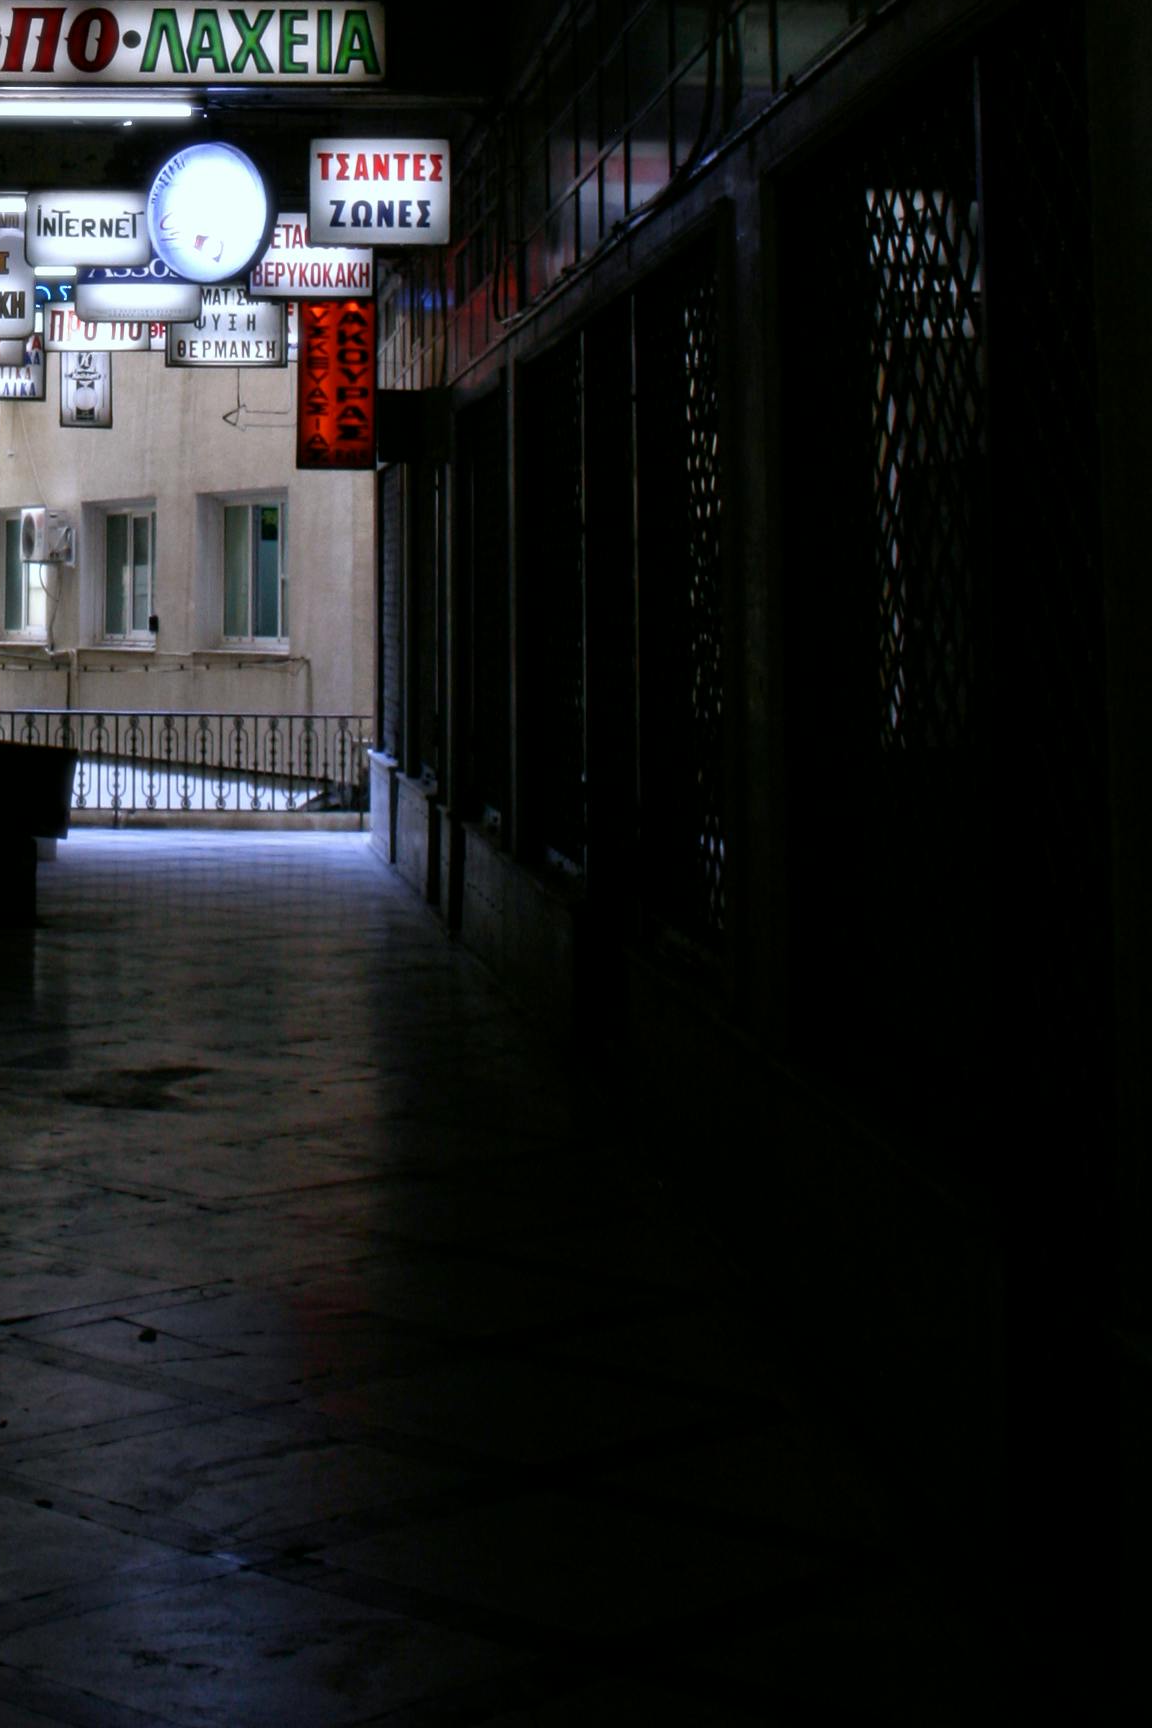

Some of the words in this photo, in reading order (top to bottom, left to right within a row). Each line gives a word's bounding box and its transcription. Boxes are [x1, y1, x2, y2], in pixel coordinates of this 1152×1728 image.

[317, 153, 443, 182] ΤΣΑΝΤΕΣ
[329, 200, 431, 228] ΖΩΝΕΣ
[252, 262, 370, 289] ΒΕΡΥΚΟΚΑΚΗ
[177, 340, 277, 359] ΘΕΡΜΑΝΣΗ
